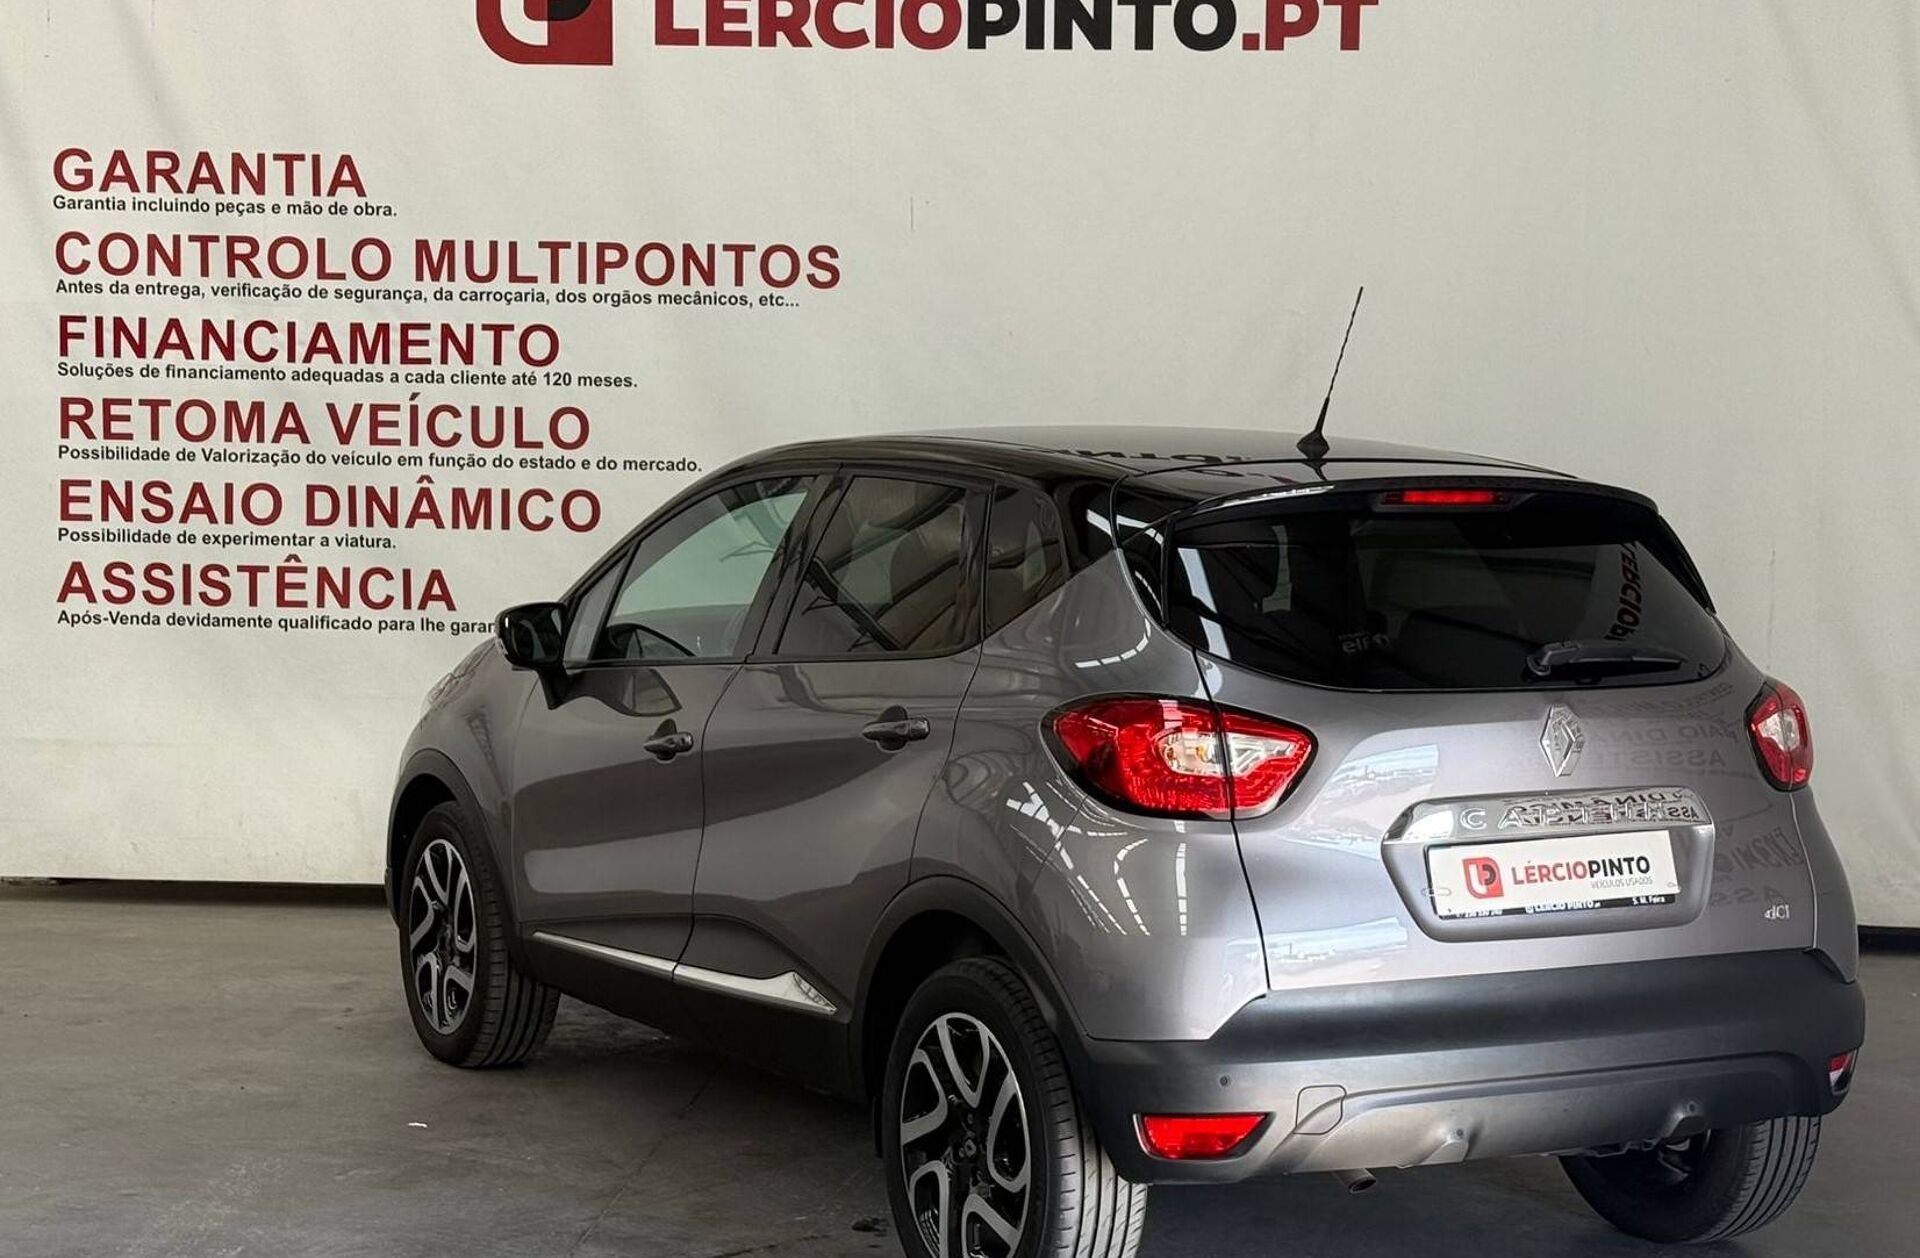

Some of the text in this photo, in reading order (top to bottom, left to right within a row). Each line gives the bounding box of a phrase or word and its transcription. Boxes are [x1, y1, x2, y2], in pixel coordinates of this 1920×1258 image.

[52, 147, 368, 199] GARANTIA
[52, 194, 398, 218] Garantia incluindo peças e mão de obra.
[54, 230, 841, 290] CONTROLO MULTIPONTOS
[55, 278, 800, 310] Antes da entrega, verificação de segurança, da carroçaria, dos orgãos mecânicos, etc...
[58, 314, 560, 369] FINANCIAMENTO
[57, 361, 638, 388] Soluções de financiamento adequadas a cada cliente até 120 meses.
[59, 391, 590, 451] RETOMA VEÍCULO
[57, 444, 703, 473] Possibilidade de Valorização do veículo em função do estado e do mercado.
[59, 473, 602, 534] ENSAIO DINÂMICO
[57, 526, 397, 550] Possibilidade de experimentar a viatura.
[55, 552, 458, 613] ASSISTÊNCIA
[56, 609, 162, 629] Após-Venda
[165, 611, 273, 629] devidamente
[277, 614, 373, 633] qualificado
[377, 619, 416, 635] para
[420, 616, 446, 633] lhe
[1626, 875, 1654, 887] USADOS
